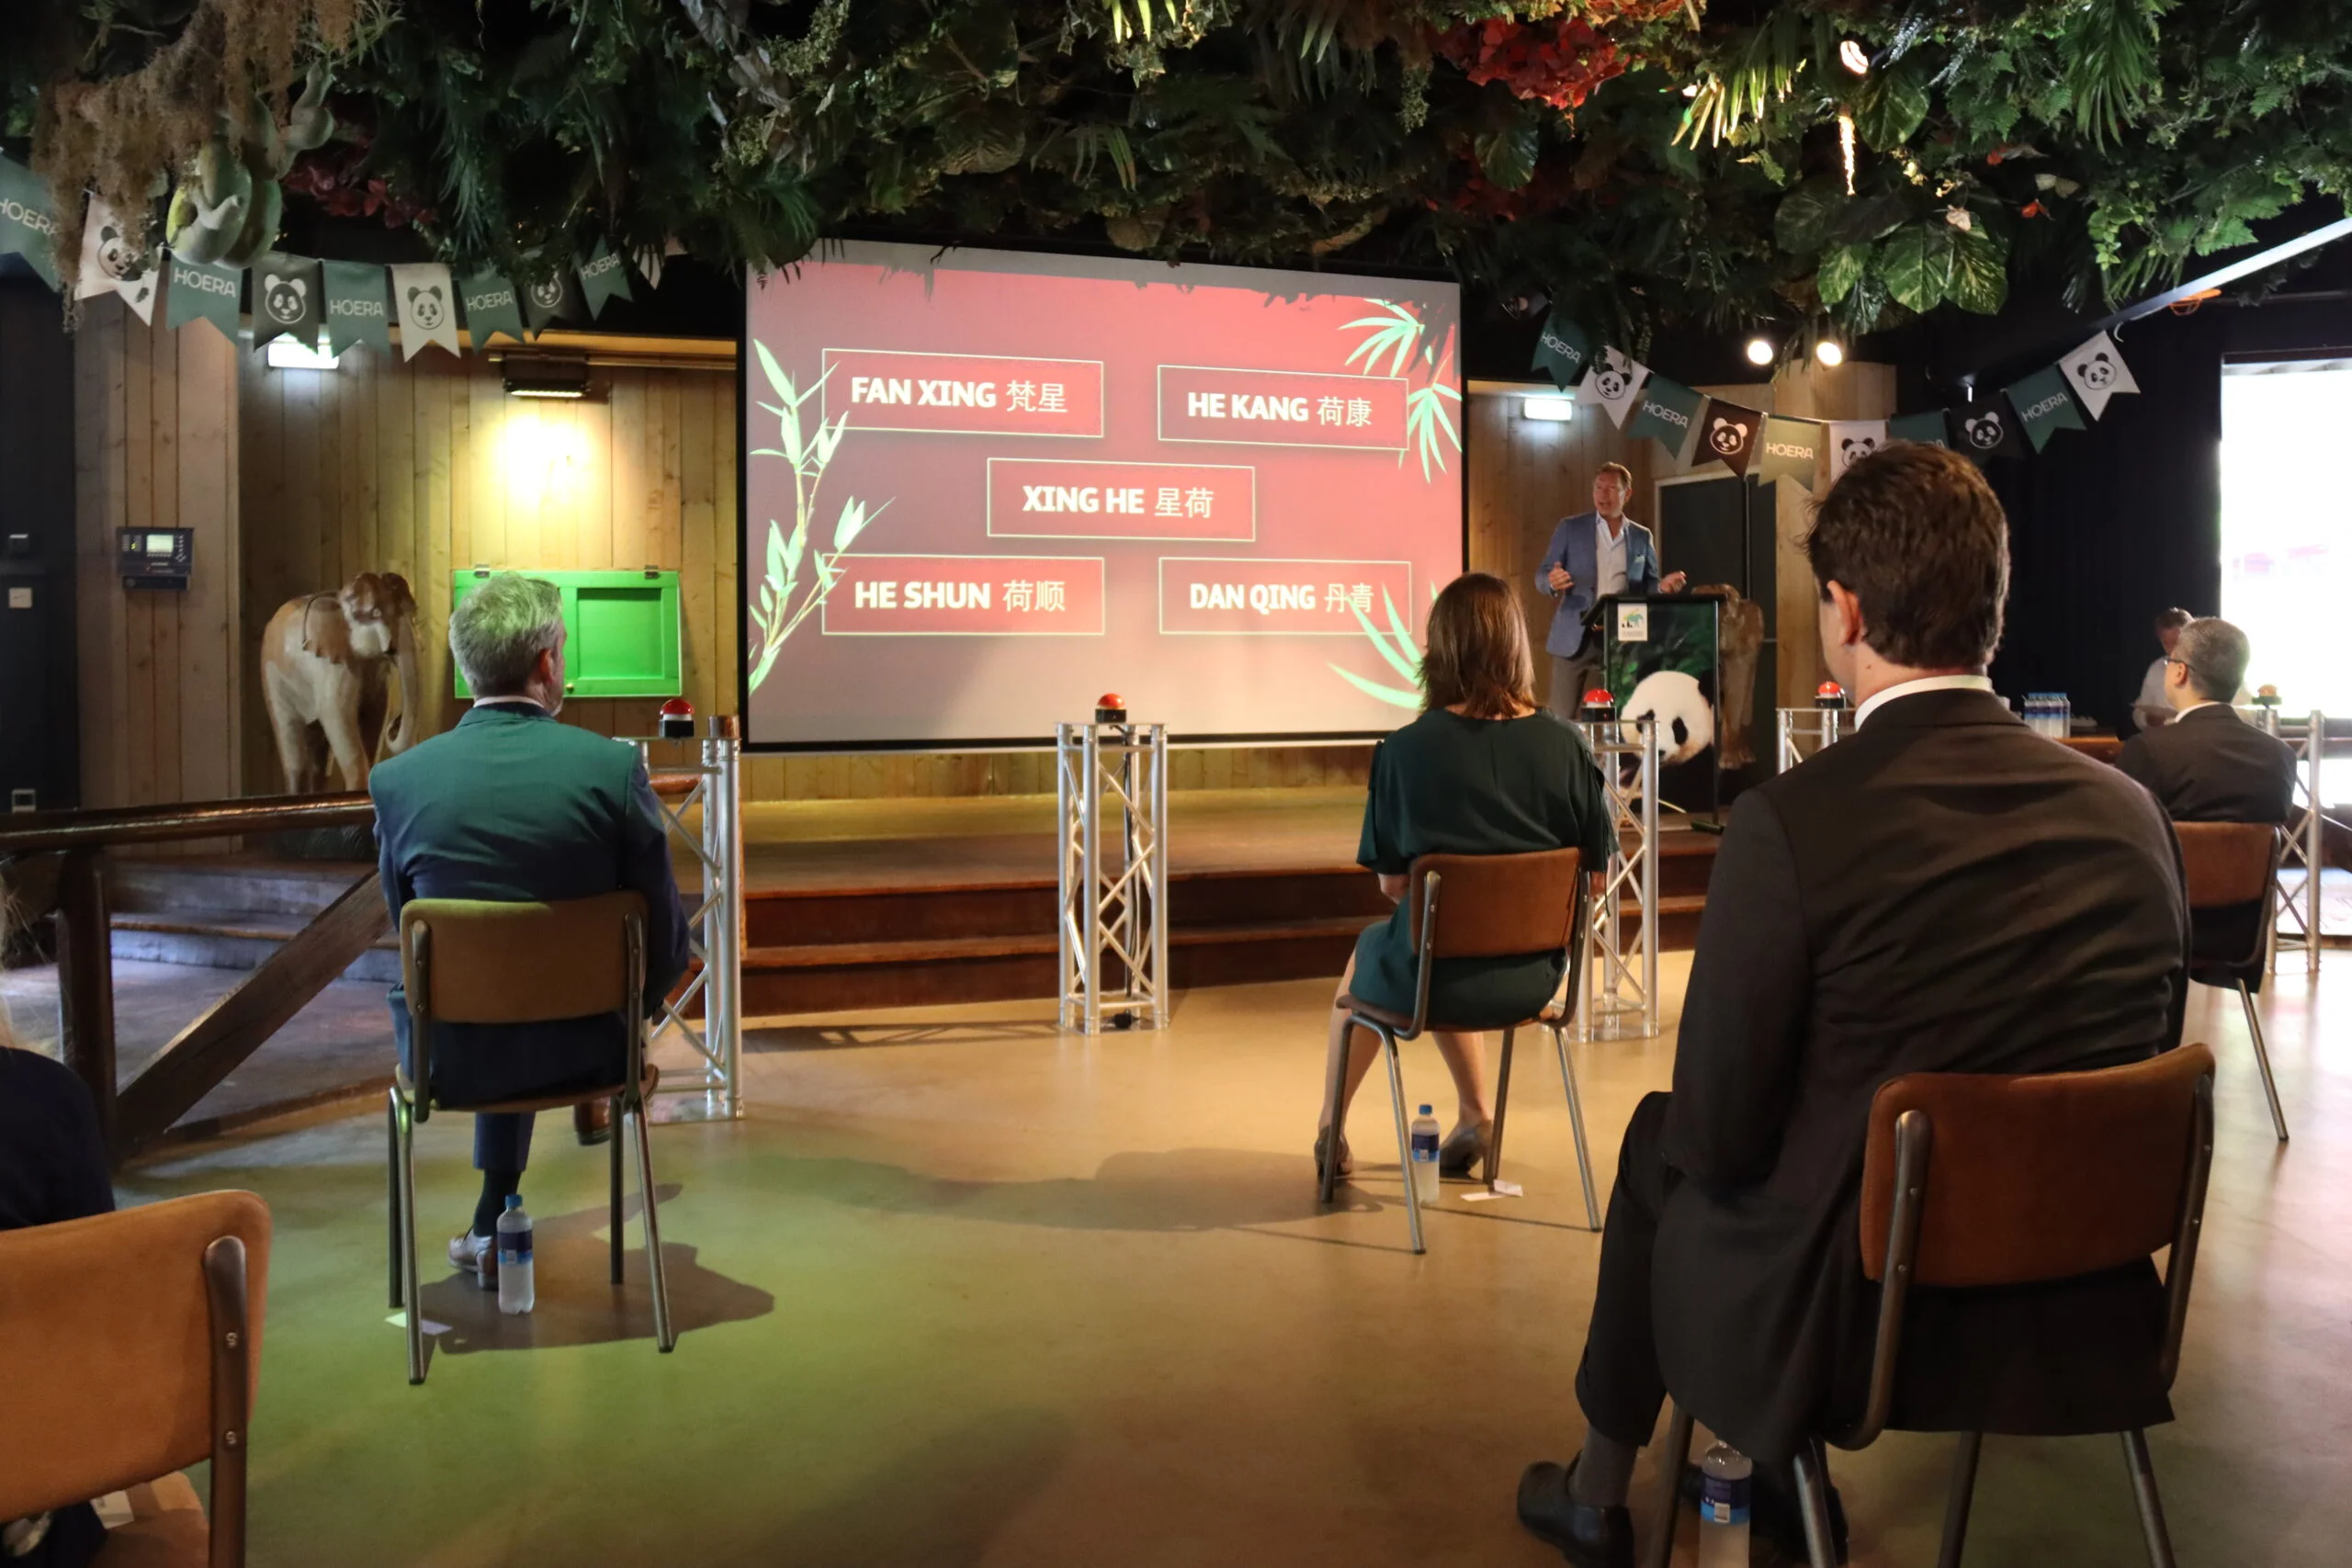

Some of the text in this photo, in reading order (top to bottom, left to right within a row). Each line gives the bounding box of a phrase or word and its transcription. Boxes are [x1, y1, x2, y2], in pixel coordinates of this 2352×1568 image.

[581, 253, 621, 280] HOERA
[173, 267, 237, 299] HOERA
[329, 299, 384, 317] HOERA
[466, 290, 514, 312] HOERA
[1541, 332, 1581, 364] HOERA
[851, 377, 1069, 412] FAN XING 梵星
[1188, 391, 1373, 427] HE KANG 荷康
[2021, 392, 2068, 423] HOERA
[1642, 400, 1689, 429] HOERA
[1766, 441, 1814, 460] HOERA
[1022, 485, 1215, 518] XING HE 星荷
[854, 579, 1066, 612] HE SHUN 荷顺
[1190, 582, 1374, 615] DAN QING 丹青
